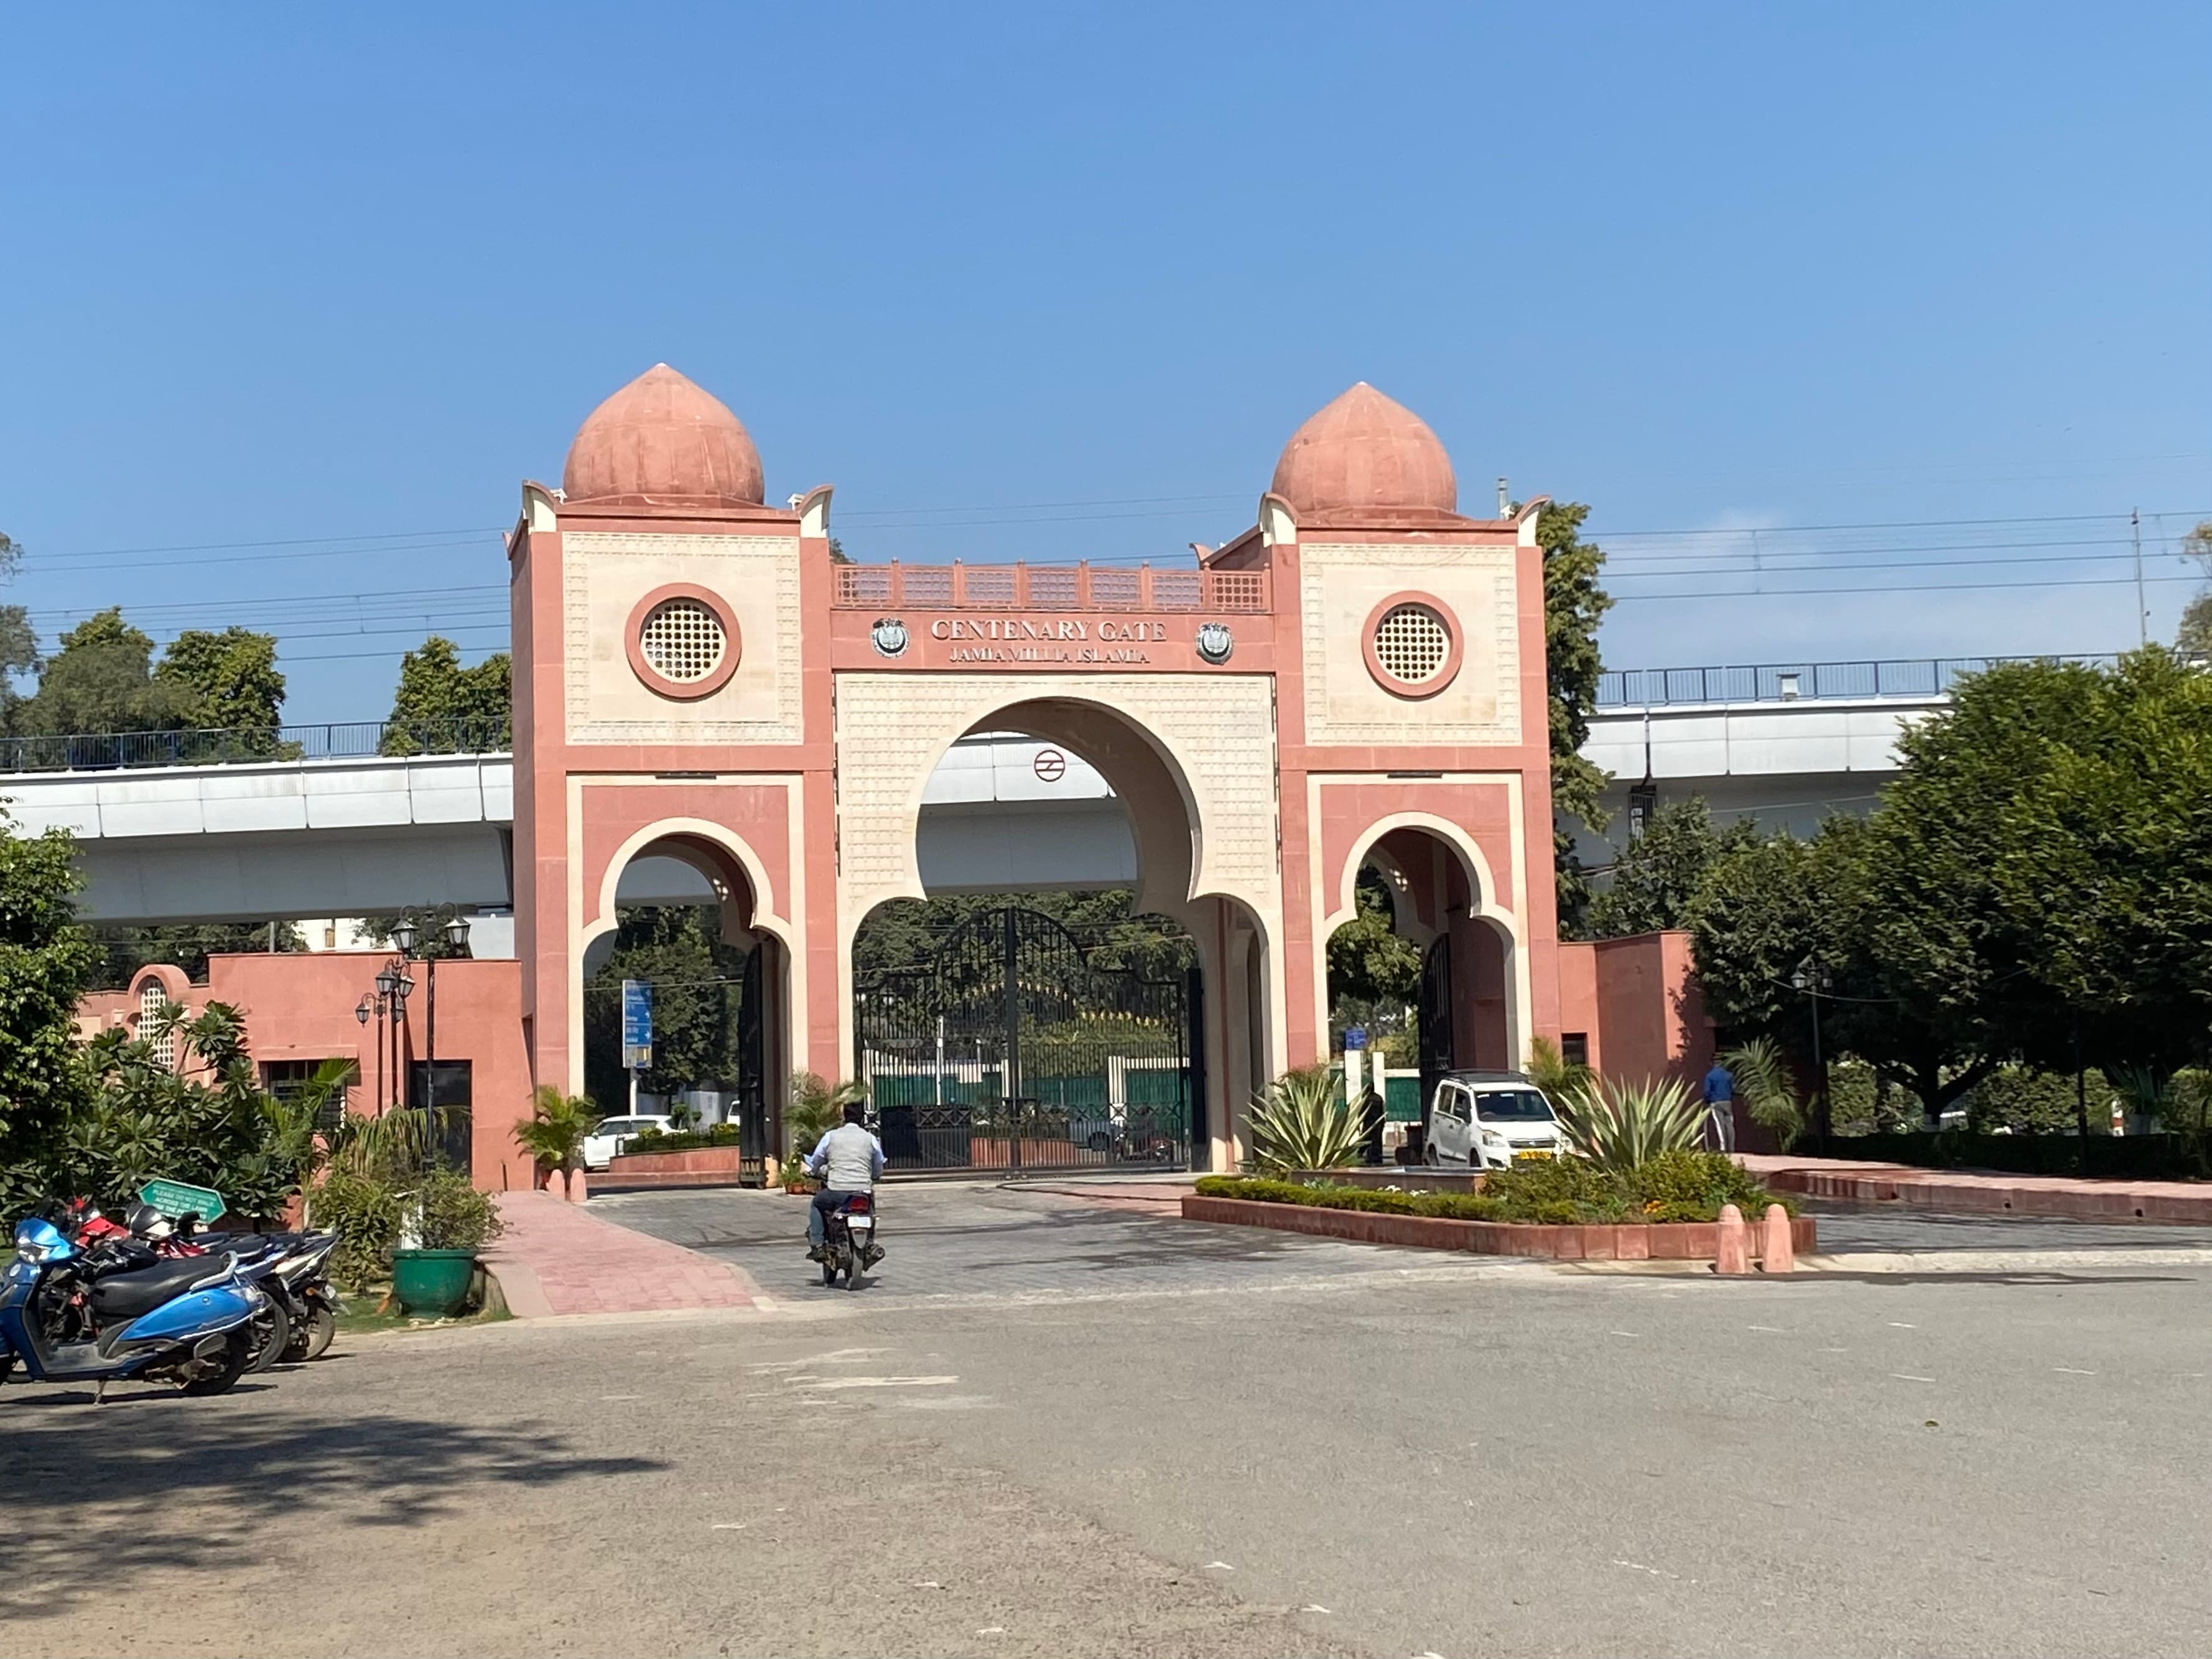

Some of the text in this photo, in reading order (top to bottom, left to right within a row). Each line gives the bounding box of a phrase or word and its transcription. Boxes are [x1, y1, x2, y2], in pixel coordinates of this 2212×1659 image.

[932, 620, 1167, 642] CENTENARY GATE
[949, 647, 1006, 662] JAMIA
[1076, 648, 1150, 664] ISLAMIA
